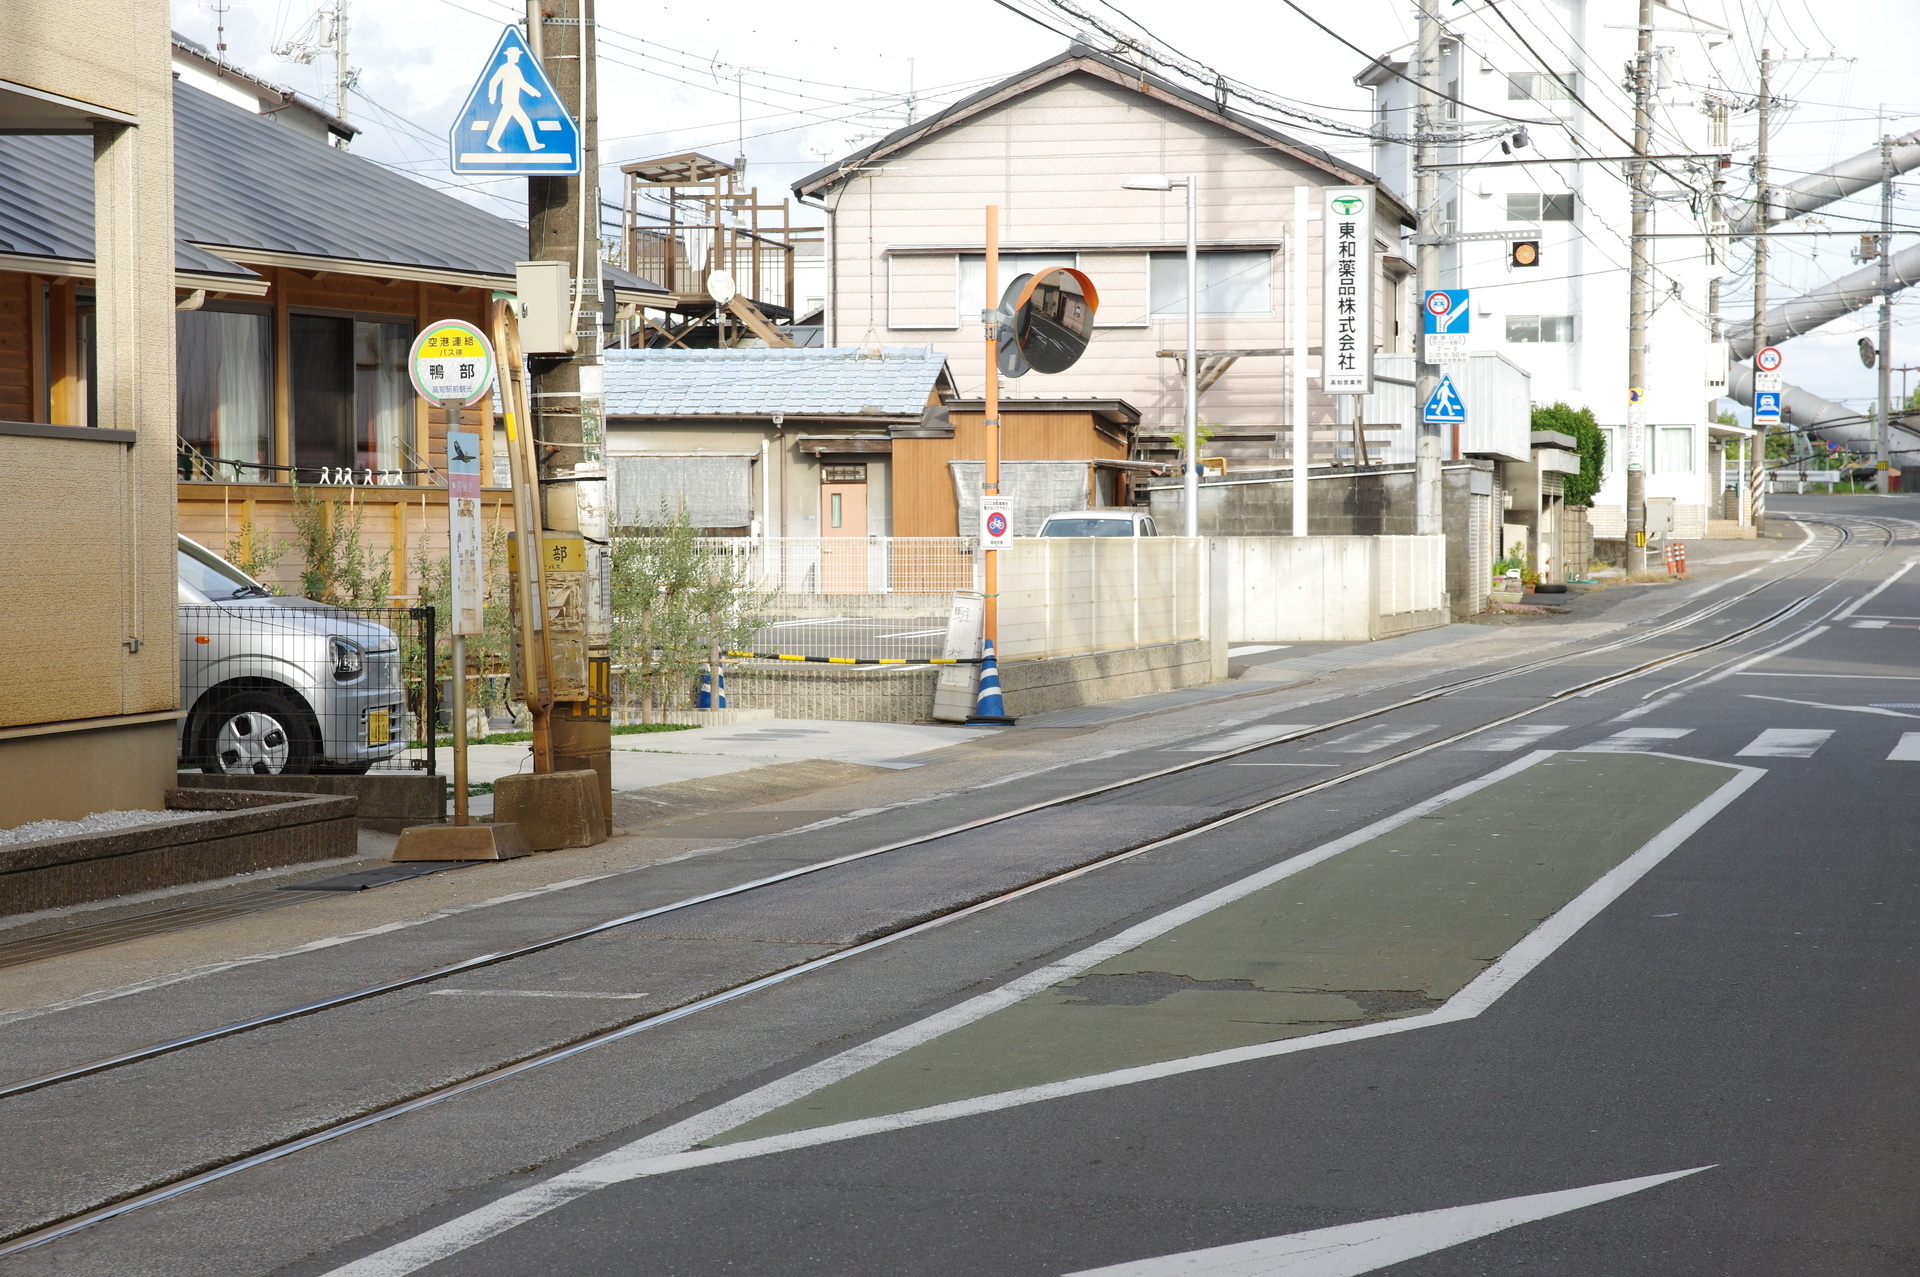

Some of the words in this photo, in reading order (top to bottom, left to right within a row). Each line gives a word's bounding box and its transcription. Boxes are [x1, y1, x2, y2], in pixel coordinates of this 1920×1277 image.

[1338, 221, 1356, 370] 東和薬品株式会社
[428, 336, 474, 347] 空港連絡
[429, 363, 475, 380] 鴨部
[432, 385, 473, 394] 高知駅前観光
